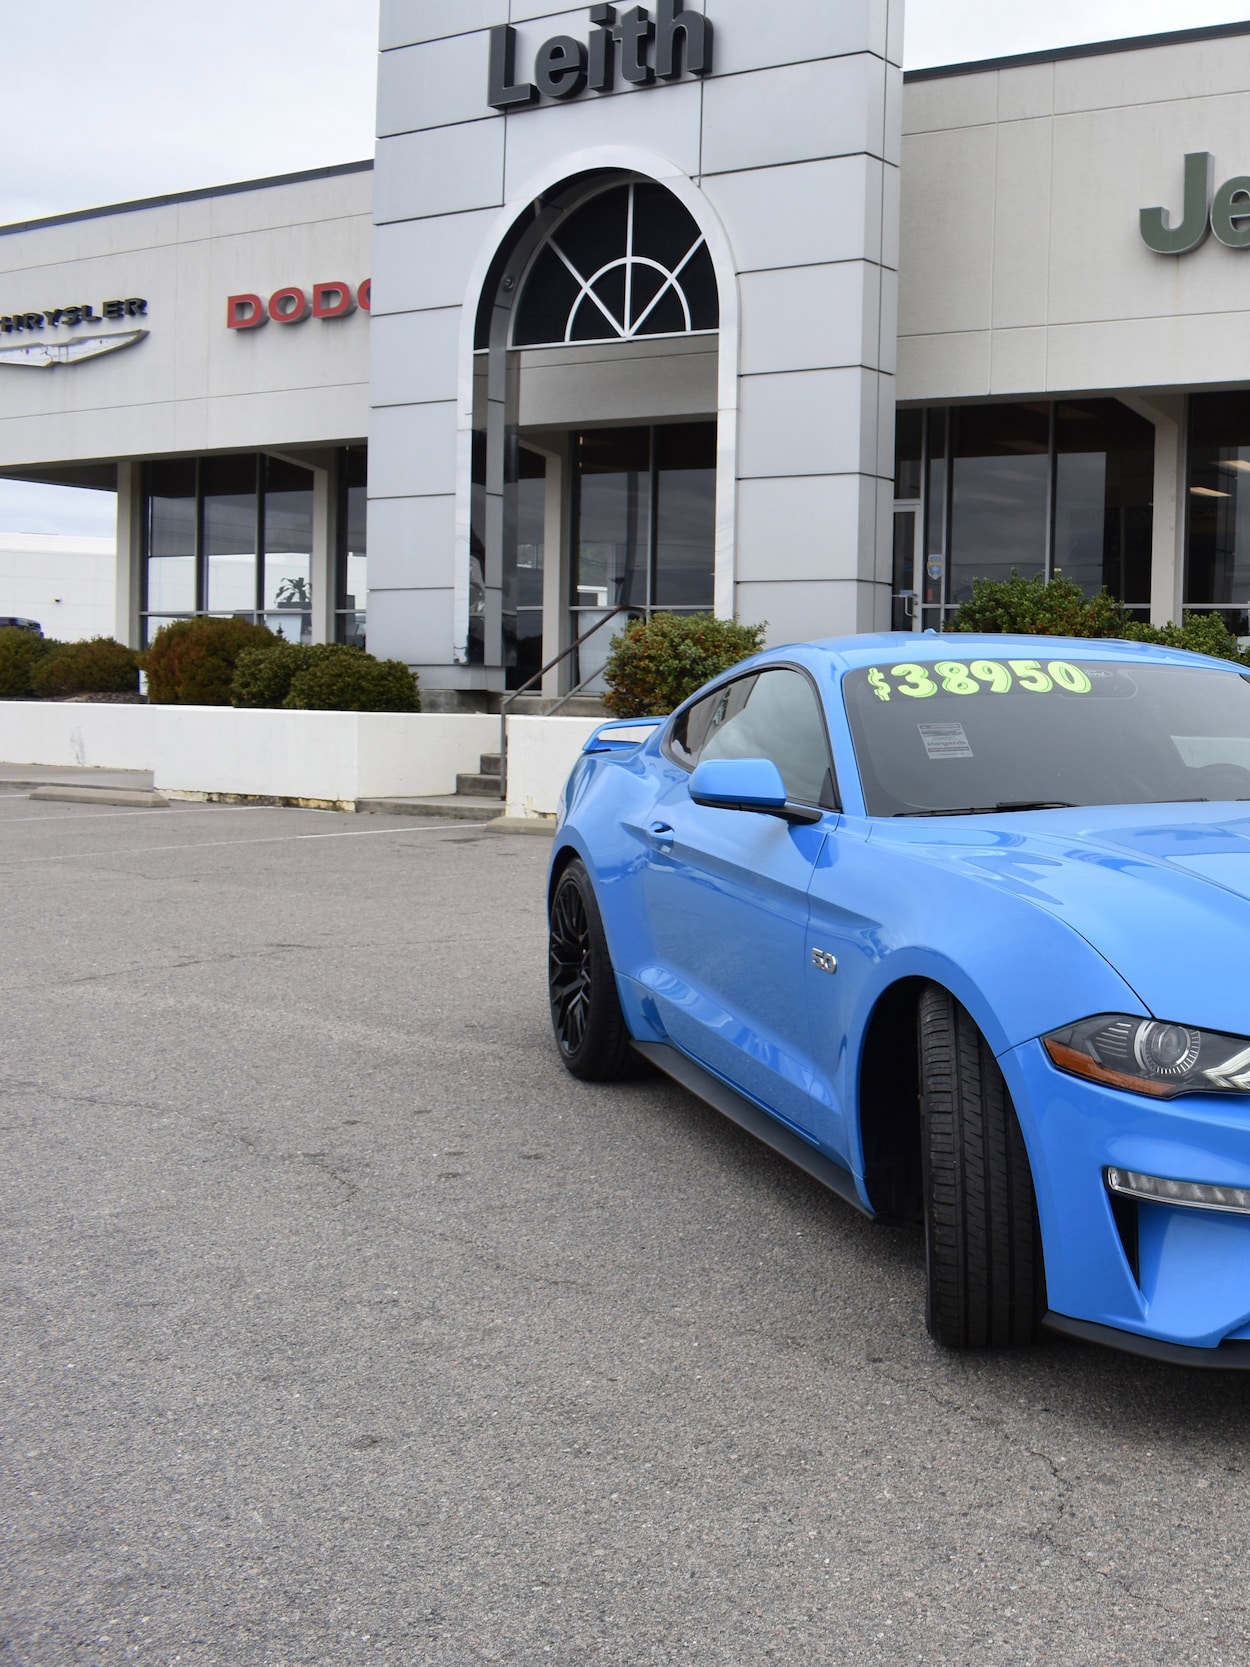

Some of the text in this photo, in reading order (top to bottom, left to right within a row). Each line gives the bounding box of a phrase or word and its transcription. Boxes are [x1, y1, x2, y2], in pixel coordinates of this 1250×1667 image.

[487, 0, 712, 109] Leith
[0, 297, 147, 333] HRYSLER
[867, 660, 1092, 701] $38950
